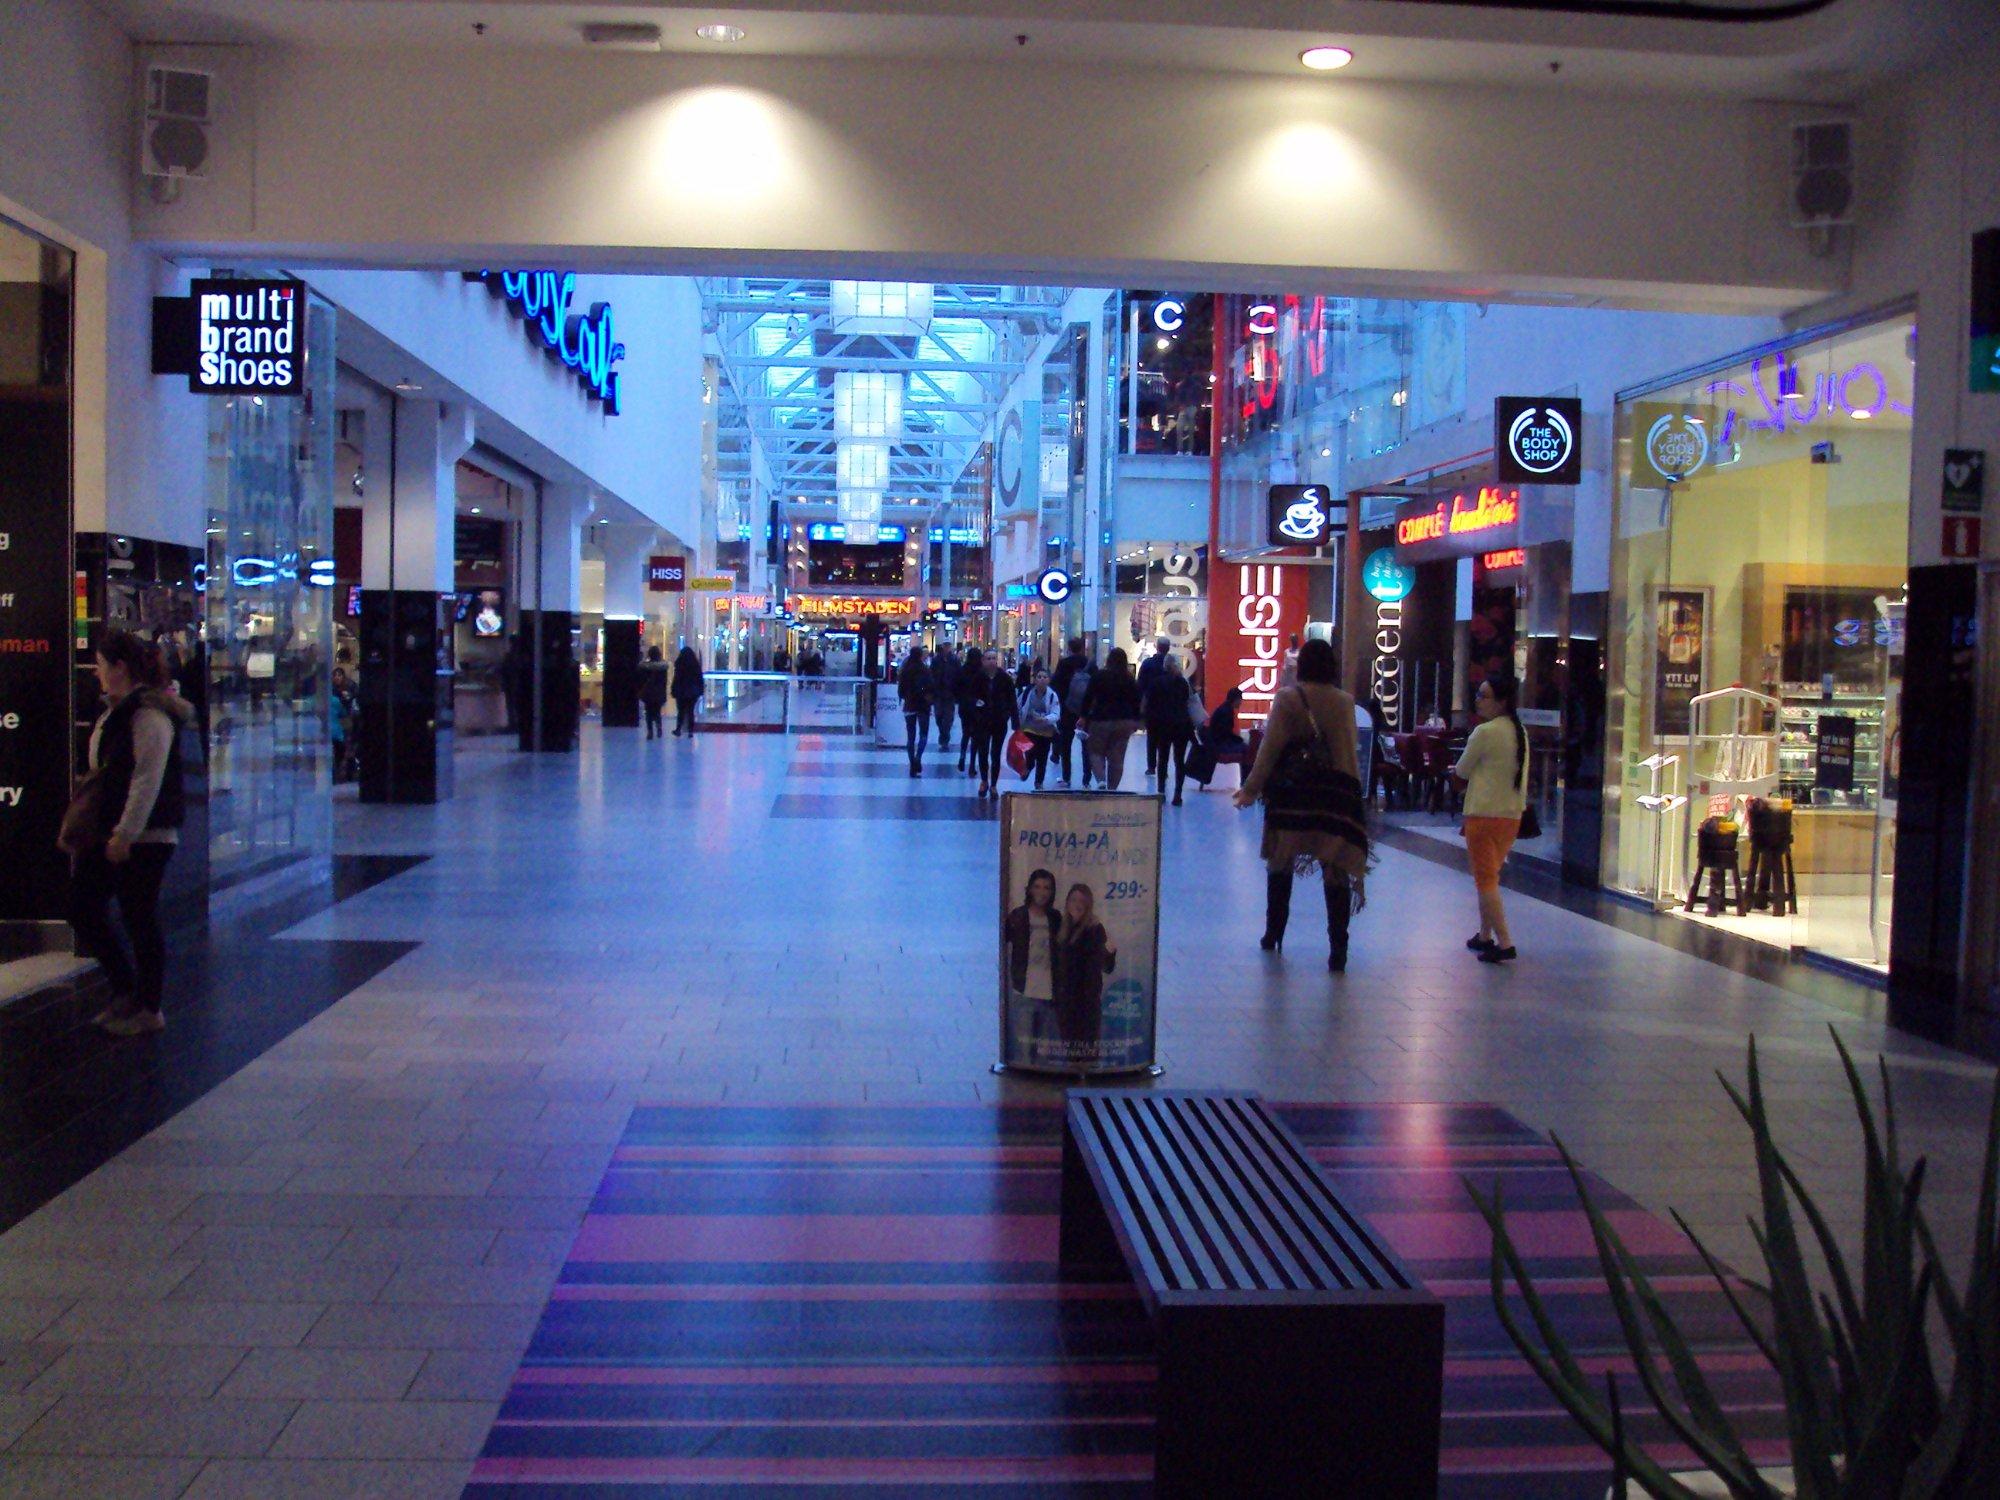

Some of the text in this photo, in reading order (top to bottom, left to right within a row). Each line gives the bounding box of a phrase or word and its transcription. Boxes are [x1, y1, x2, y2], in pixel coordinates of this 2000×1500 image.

[201, 288, 294, 321] multi
[200, 320, 294, 354] brand
[200, 352, 293, 386] Shoes
[1529, 427, 1552, 438] THE
[1521, 437, 1560, 450] BODY
[1523, 449, 1558, 461] SHOP
[652, 568, 682, 580] HISS
[801, 599, 911, 614] FILMSTADEN
[0, 639, 49, 653] man
[1371, 581, 1402, 727] accent
[1018, 829, 1110, 849] PROVA-PÅ
[1105, 880, 1148, 899] 299:-
